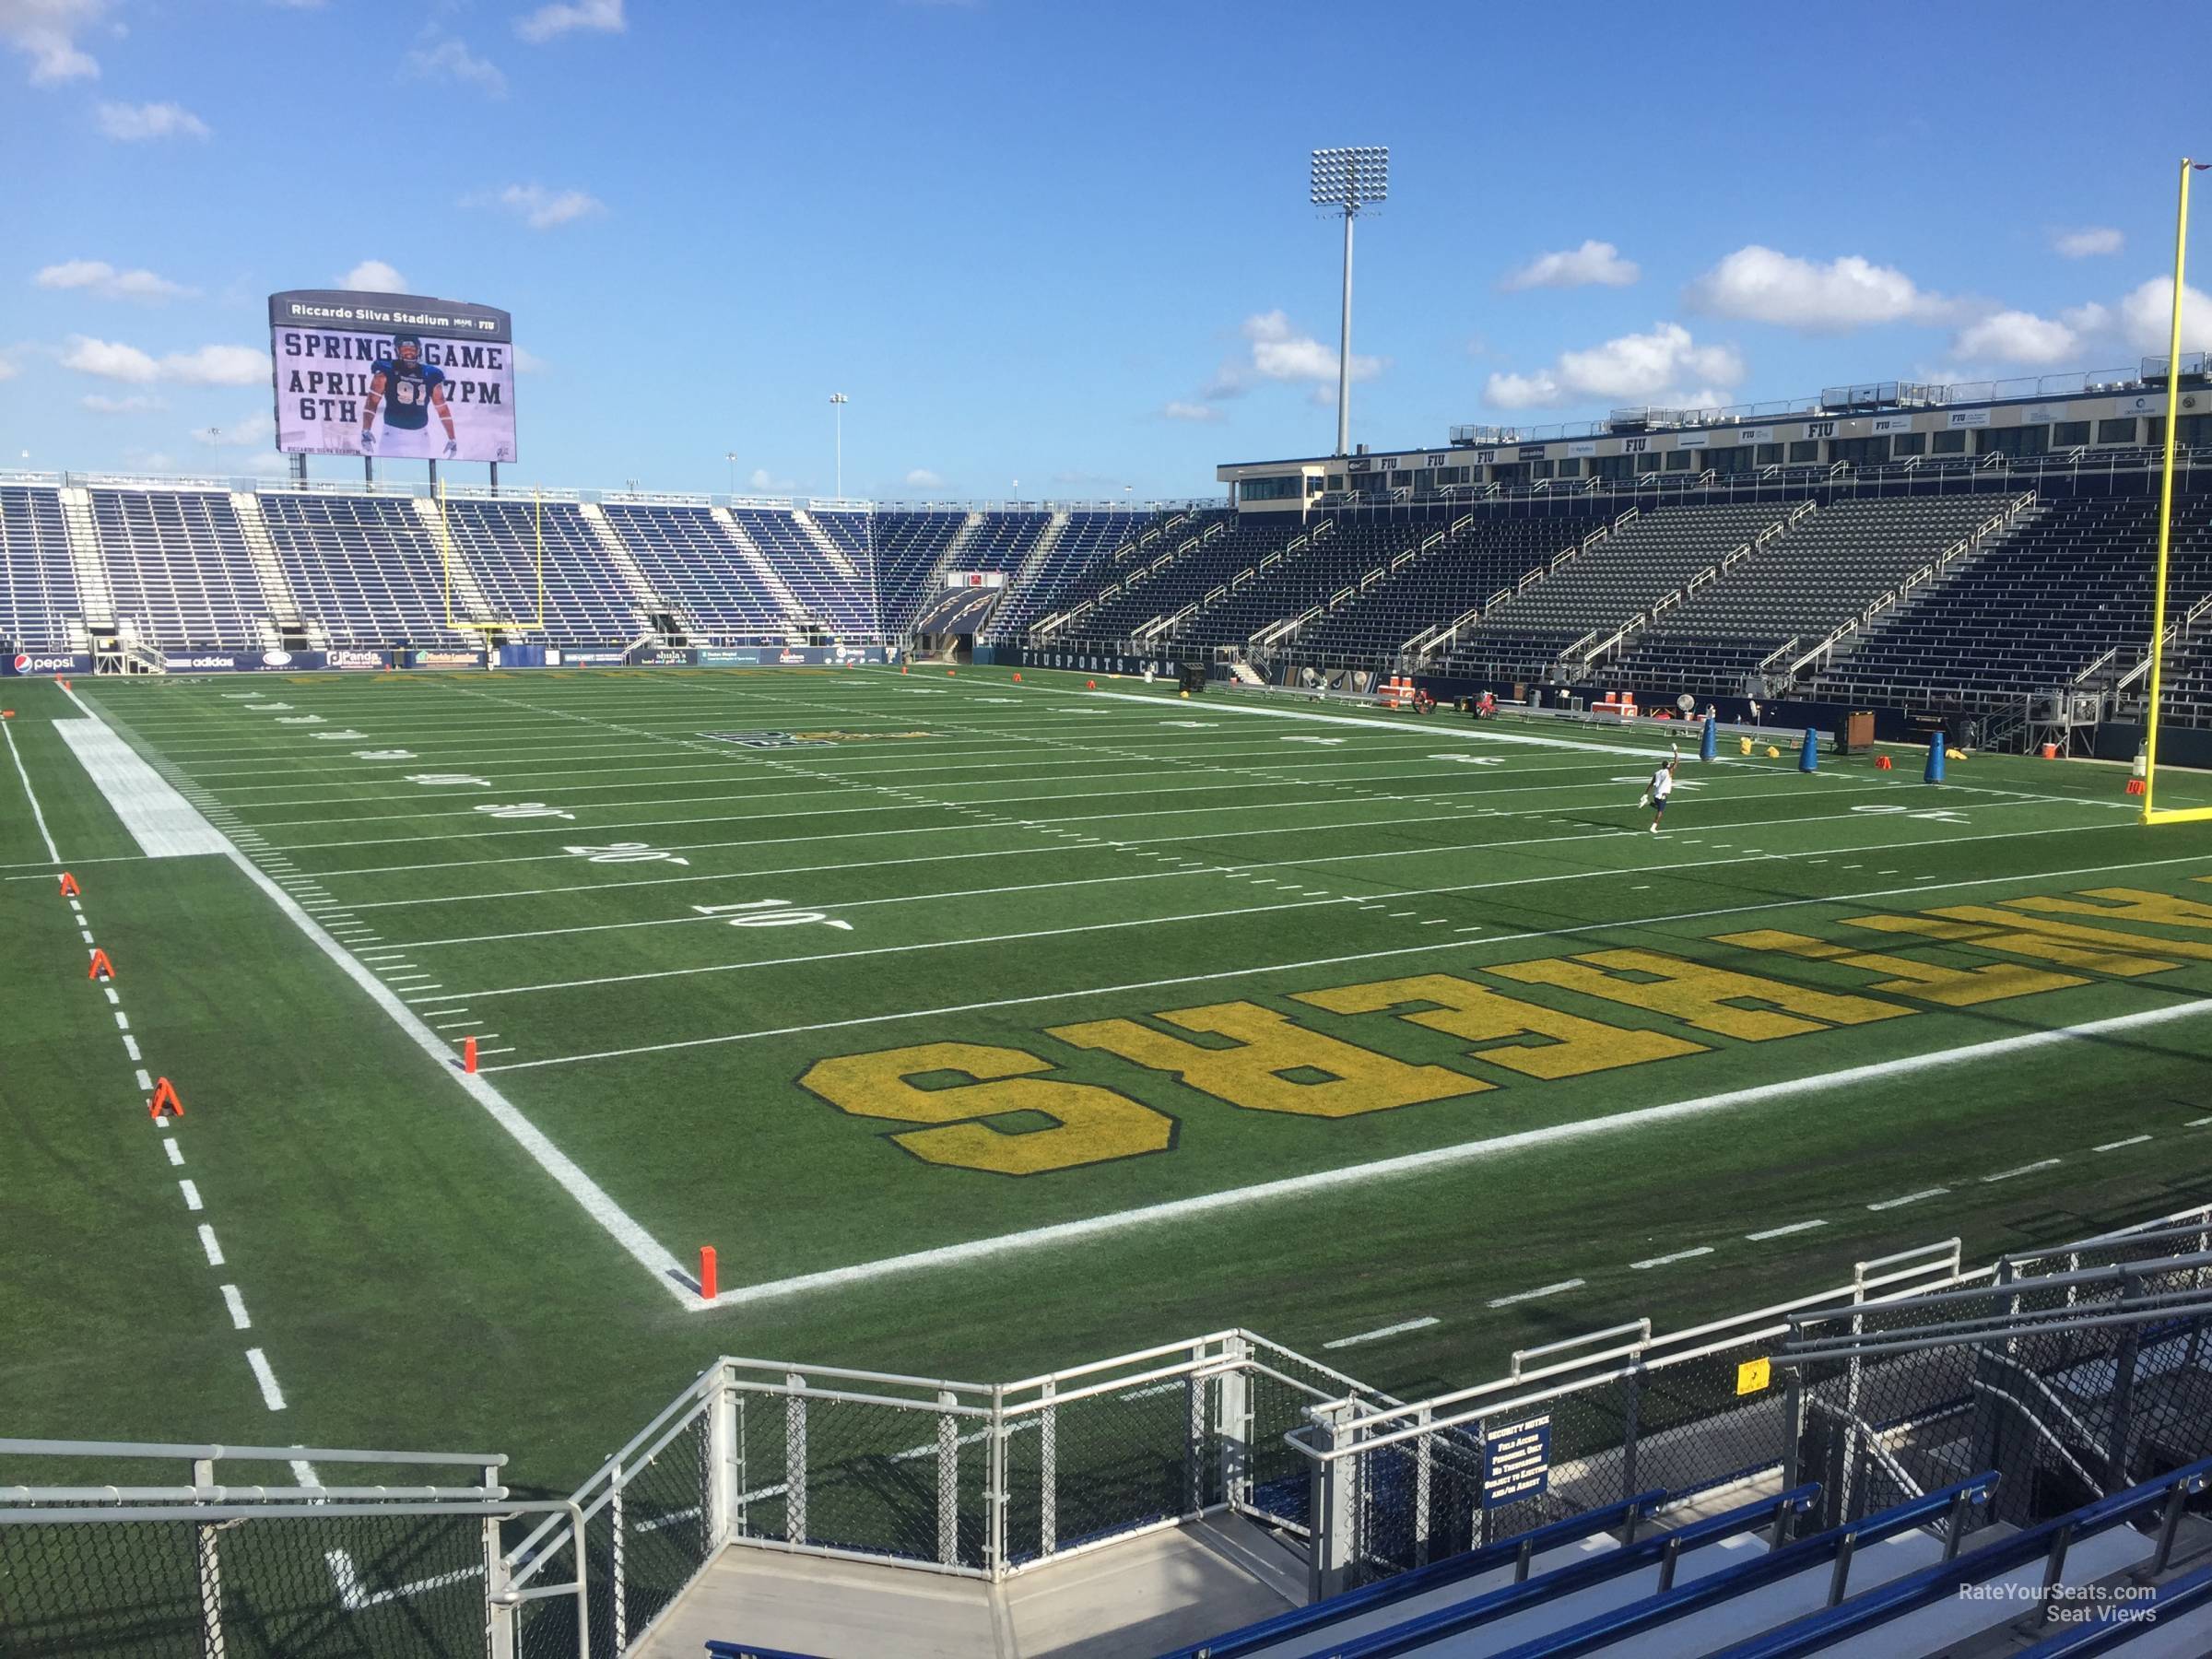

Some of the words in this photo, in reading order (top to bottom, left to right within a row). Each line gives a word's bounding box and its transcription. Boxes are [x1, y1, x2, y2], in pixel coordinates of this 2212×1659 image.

[291, 304, 353, 318] Riccardo
[356, 309, 390, 322] Silva
[394, 312, 449, 326] Stadium
[478, 321, 495, 330] FIU
[285, 333, 392, 361] SPRING
[425, 343, 503, 371] GAME
[288, 371, 370, 397] APRIL
[442, 380, 501, 405] 7PM
[396, 381, 427, 406] 91
[300, 397, 357, 423] 6TH
[1808, 422, 1834, 439] FIU
[1877, 421, 1890, 430] FIU
[1742, 430, 1755, 440] FIU
[1626, 438, 1647, 453] FIU
[1382, 458, 1397, 470] FIU
[1428, 454, 1446, 466] FIU
[1477, 451, 1495, 464] FIU
[193, 656, 234, 667] adidas
[656, 651, 687, 659] shula's
[34, 657, 74, 670] pepsi
[2129, 782, 2140, 794] 10
[474, 803, 564, 818] 30
[562, 841, 671, 863] 20
[692, 899, 826, 926] 10
[1488, 1423, 1524, 1441] SECURITY
[1524, 1416, 1550, 1430] NOTICE
